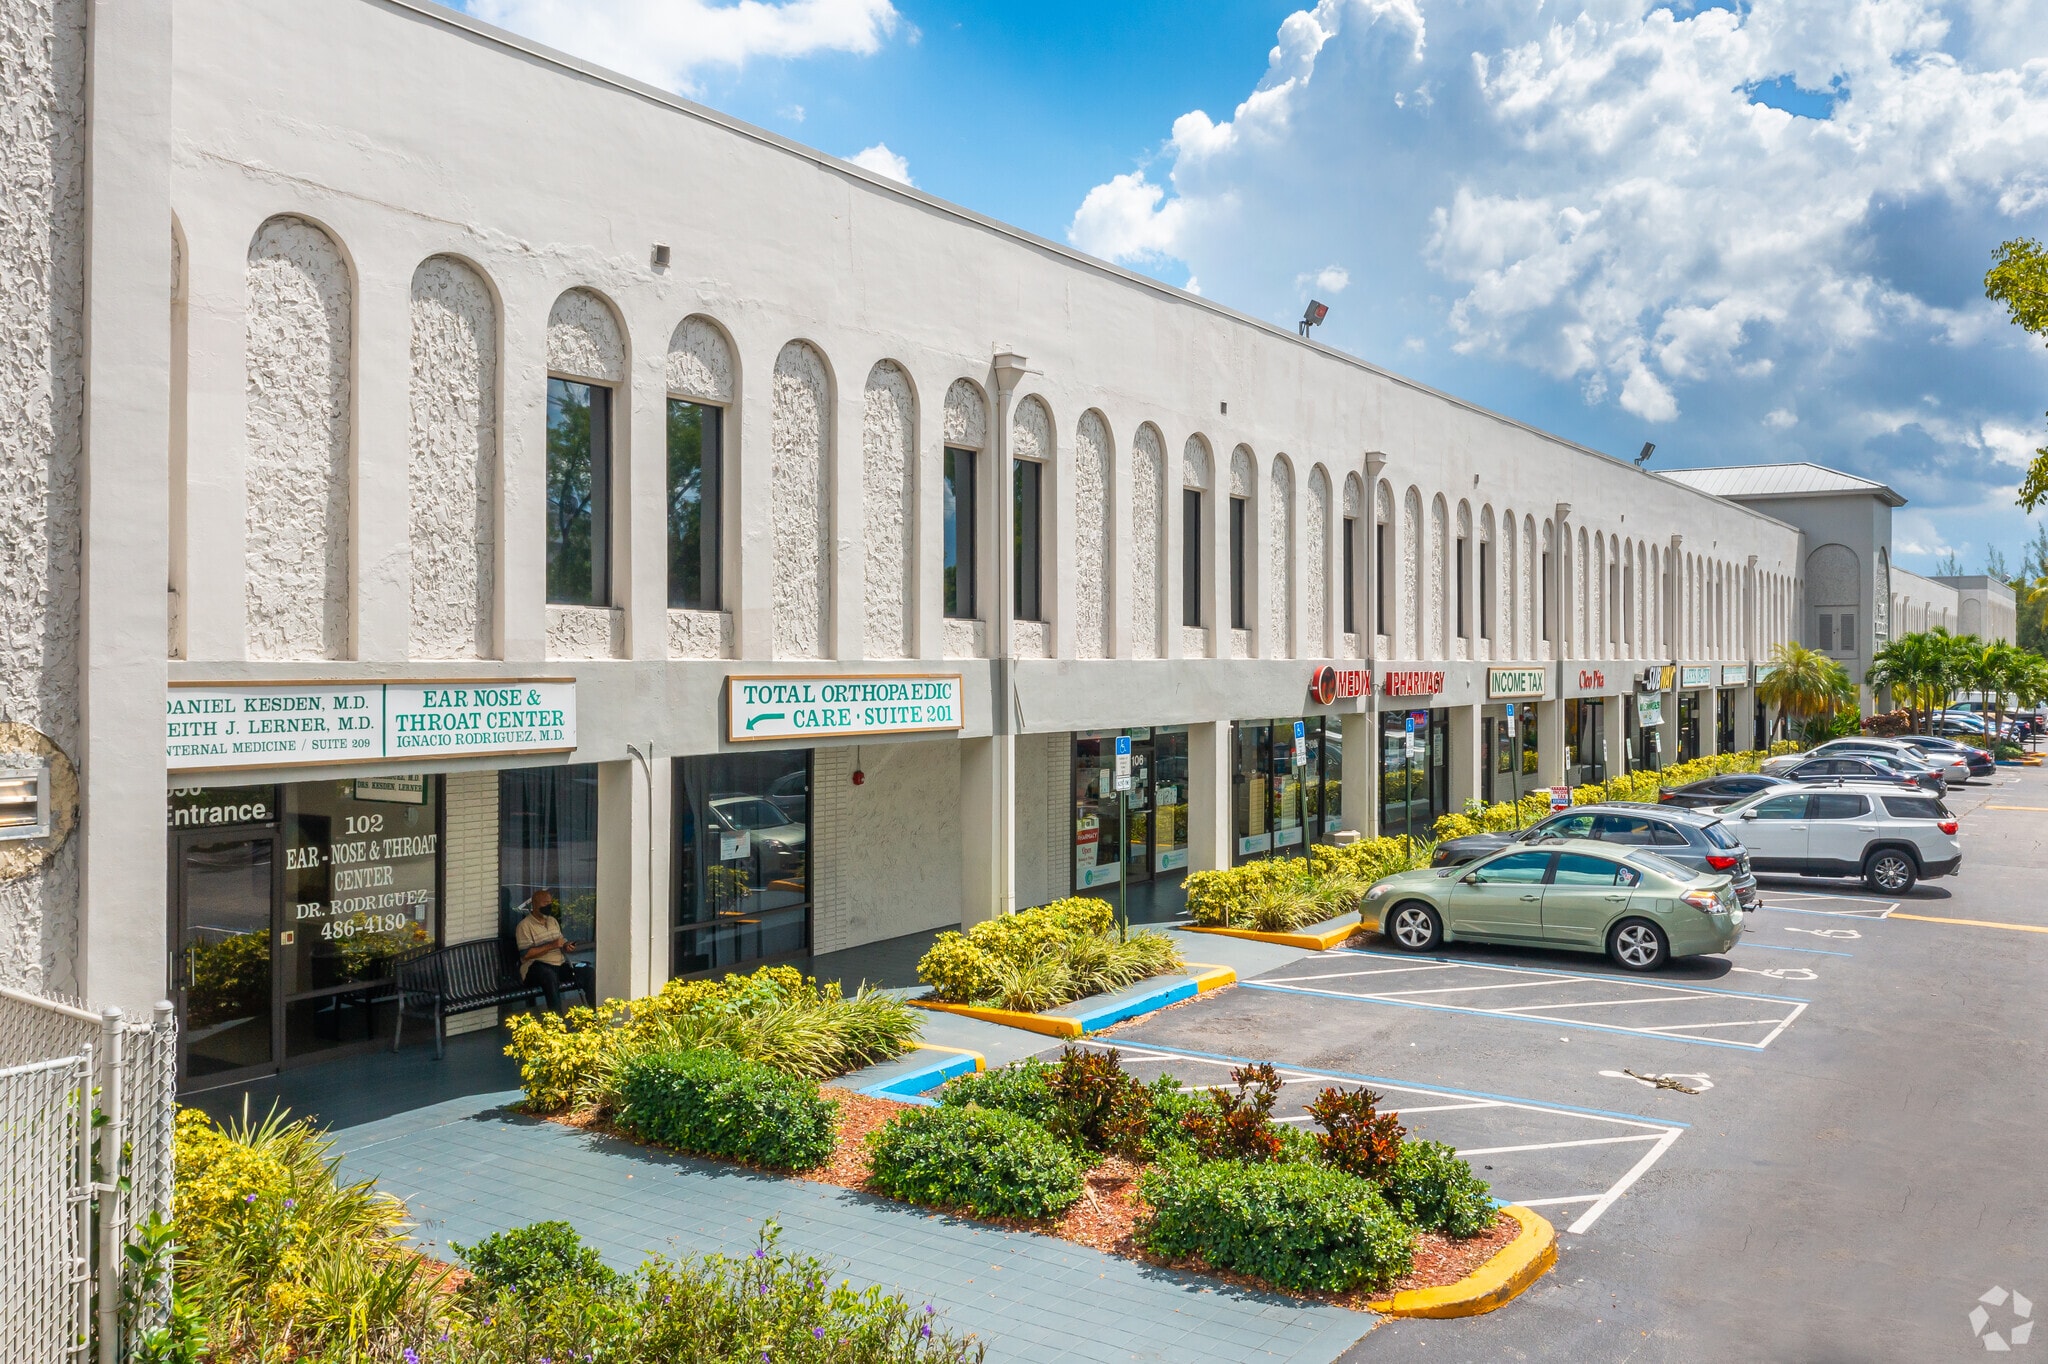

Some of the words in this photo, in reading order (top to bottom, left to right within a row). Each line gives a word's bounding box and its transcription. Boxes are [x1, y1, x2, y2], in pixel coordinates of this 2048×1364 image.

[1336, 670, 1372, 698] MEDIX
[1390, 672, 1445, 696] PHARMACY
[1492, 672, 1526, 692] INCOME
[1528, 672, 1542, 692] TAX
[1642, 666, 1676, 690] SUBWAY
[423, 690, 468, 708] EAR
[474, 690, 522, 706] NOSE
[526, 689, 542, 706] &
[744, 685, 816, 704] TOTAL
[822, 683, 952, 702] ORTHOPAEDIC
[167, 698, 236, 714] ANIEL
[244, 697, 325, 713] KESDEN,
[333, 696, 369, 710] M.D.
[168, 721, 218, 737] EITH
[226, 721, 240, 735] J.
[249, 718, 330, 734] LERNER,
[338, 716, 374, 730] M.D.
[396, 712, 481, 732] THROAT
[486, 710, 565, 728] CENTER
[793, 708, 850, 728] CARE
[864, 706, 922, 725] SUITE
[927, 705, 952, 722] 201
[166, 744, 227, 756] NTERNAL
[232, 740, 296, 754] MEDICINE
[312, 739, 348, 750] SUITE
[352, 738, 370, 748] 209
[397, 734, 450, 748] IGNACIO
[456, 730, 536, 745] RODRIGUEZ,
[540, 730, 564, 741] M.D.
[345, 814, 384, 834] 102
[286, 846, 319, 870] EAR
[330, 842, 366, 865] NOSE
[369, 840, 380, 860] &
[383, 834, 437, 858] THROAT
[334, 866, 394, 892] CENTER
[296, 902, 326, 920] DR.
[330, 889, 428, 915] RODRIGUEZ
[321, 913, 406, 940] 486-4180
